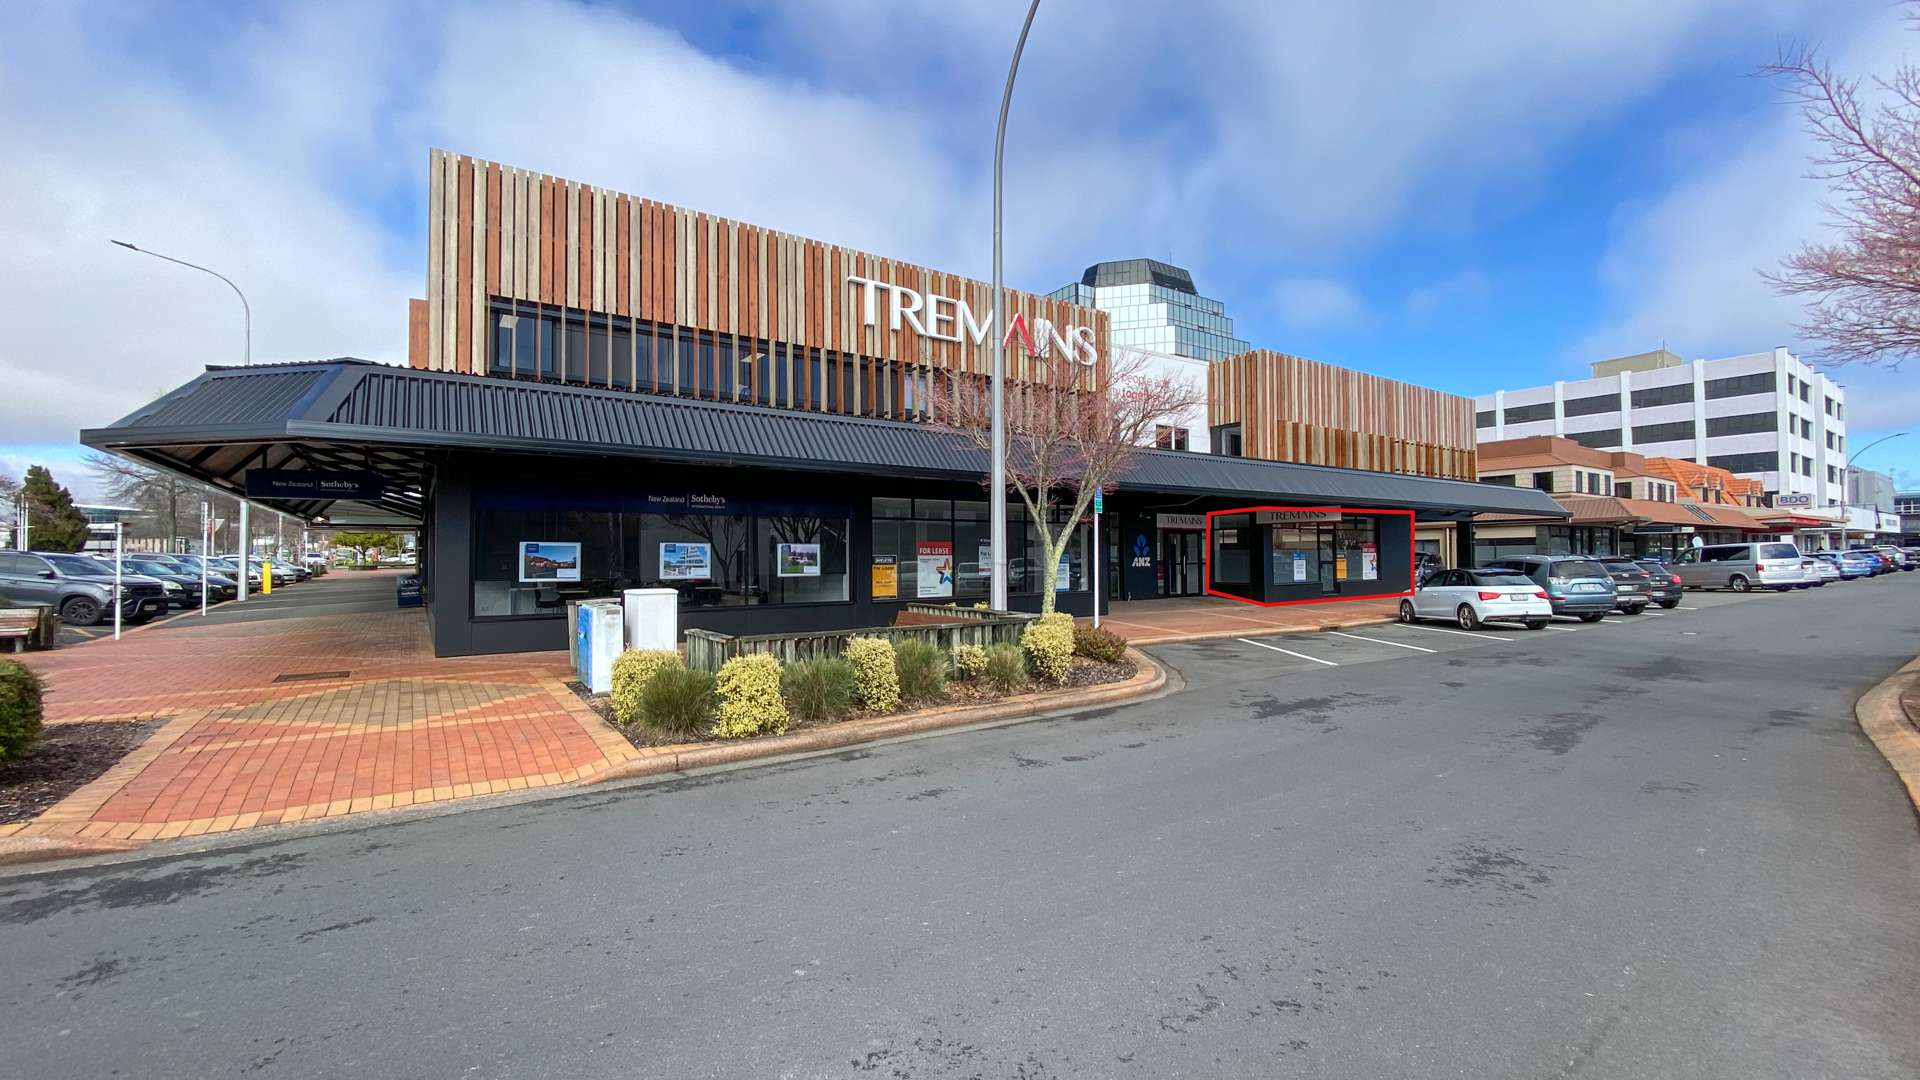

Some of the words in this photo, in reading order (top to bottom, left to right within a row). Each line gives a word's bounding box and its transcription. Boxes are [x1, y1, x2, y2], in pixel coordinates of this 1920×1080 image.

[847, 275, 1098, 366] TREMAINS
[320, 480, 359, 489] Sotheby's
[648, 495, 661, 503] New
[662, 495, 685, 503] Zealand
[691, 494, 726, 505] Sotheby's
[1780, 495, 1809, 504] BDO
[1167, 515, 1202, 526] TREMAINS
[1270, 512, 1328, 521] TREMAINS
[919, 547, 931, 555] FOR
[932, 547, 949, 555] LEASE
[1131, 556, 1151, 567] ANZ
